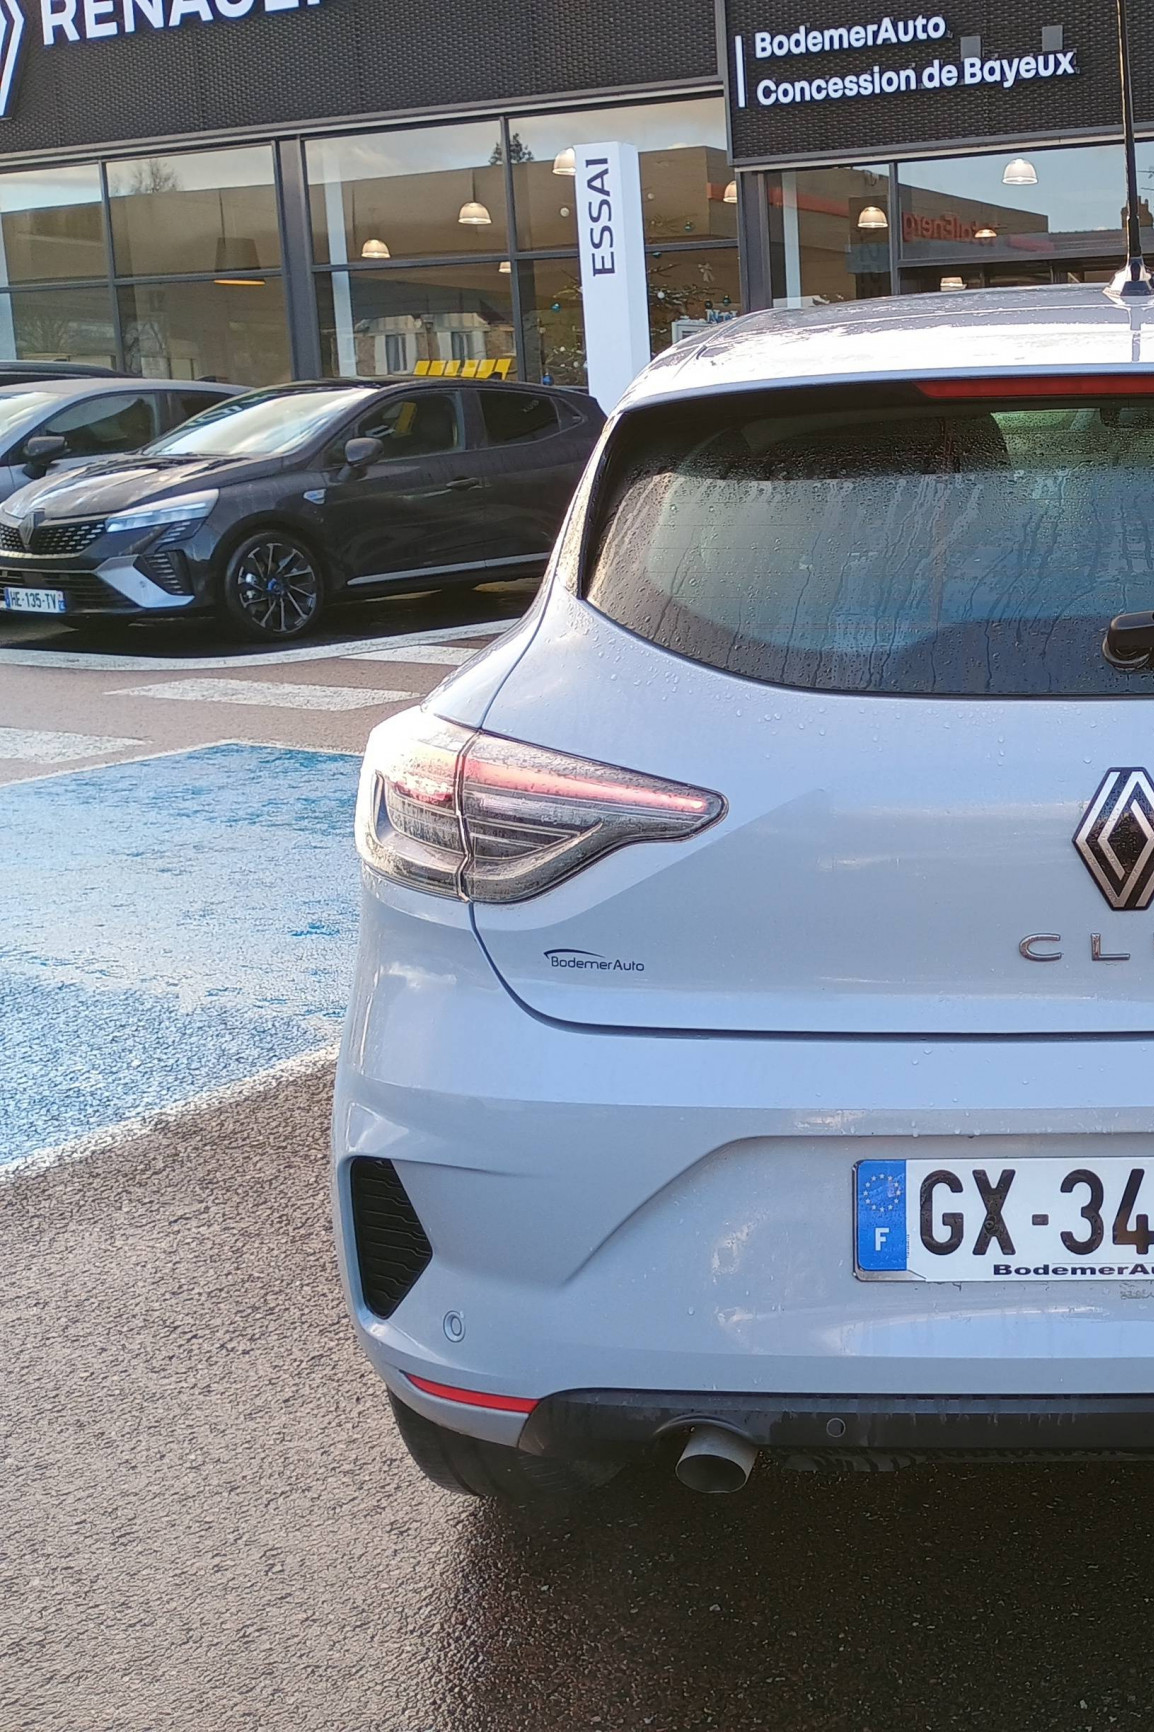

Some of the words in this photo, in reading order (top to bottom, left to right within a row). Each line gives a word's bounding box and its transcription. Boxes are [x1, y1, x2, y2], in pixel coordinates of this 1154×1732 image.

[41, 0, 321, 45] RENA
[754, 14, 947, 59] BodemerAuto
[756, 65, 917, 106] Concession
[921, 59, 959, 89] de
[963, 50, 1076, 88] Bayeux
[585, 157, 616, 277] ESSAI
[551, 956, 645, 971] BodemerAuto
[875, 1227, 889, 1251] F
